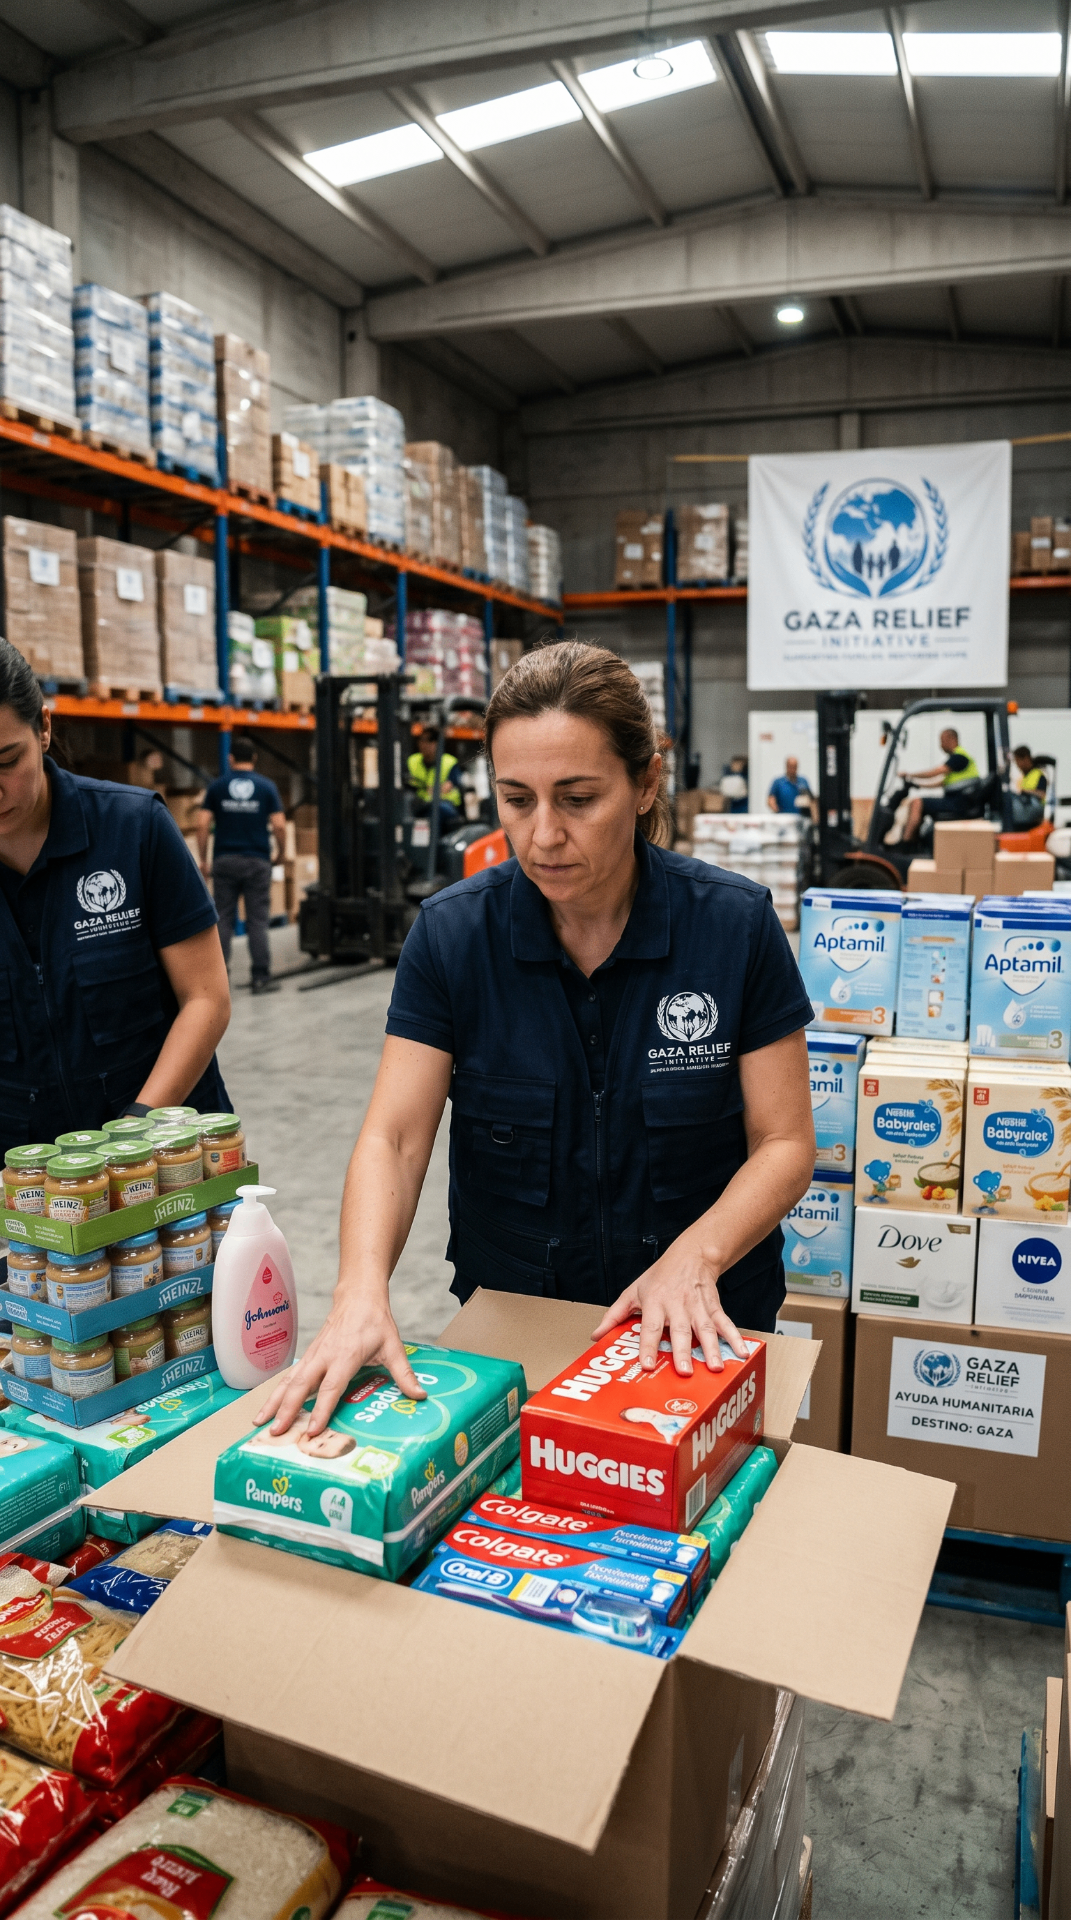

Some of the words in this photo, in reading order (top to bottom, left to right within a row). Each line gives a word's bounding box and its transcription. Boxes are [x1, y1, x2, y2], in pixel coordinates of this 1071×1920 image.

[784, 610, 862, 631] GAZA
[873, 607, 970, 629] RELIEF
[821, 634, 930, 648] INITIATIVE
[74, 917, 104, 930] GAZA
[813, 933, 885, 953] Aptamil
[984, 953, 1062, 975] Aptamil
[873, 1006, 886, 1025] 3
[1049, 1030, 1063, 1049] 3
[648, 1046, 685, 1059] GAZA
[688, 1042, 731, 1056] RELIEF
[834, 1144, 846, 1161] 3
[53, 1200, 79, 1210] HEINZ
[787, 1205, 839, 1222] ptamil
[877, 1224, 942, 1252] Dove
[1017, 1254, 1057, 1267] NIVEA
[830, 1270, 842, 1288] 3
[966, 1356, 1020, 1375] GAZA
[965, 1370, 1020, 1388] RELIEF
[895, 1391, 939, 1406] AYUDA
[942, 1397, 1034, 1418] HUMANITARIA
[692, 1370, 756, 1471] HUGGIES
[911, 1415, 973, 1434] DESTINO:
[976, 1425, 1014, 1439] GAZA
[530, 1434, 665, 1496] HUGGIES
[245, 1478, 303, 1513] Pampers
[411, 1470, 446, 1509] Pampers
[480, 1499, 588, 1532] Colgate
[452, 1529, 564, 1566] Colgate
